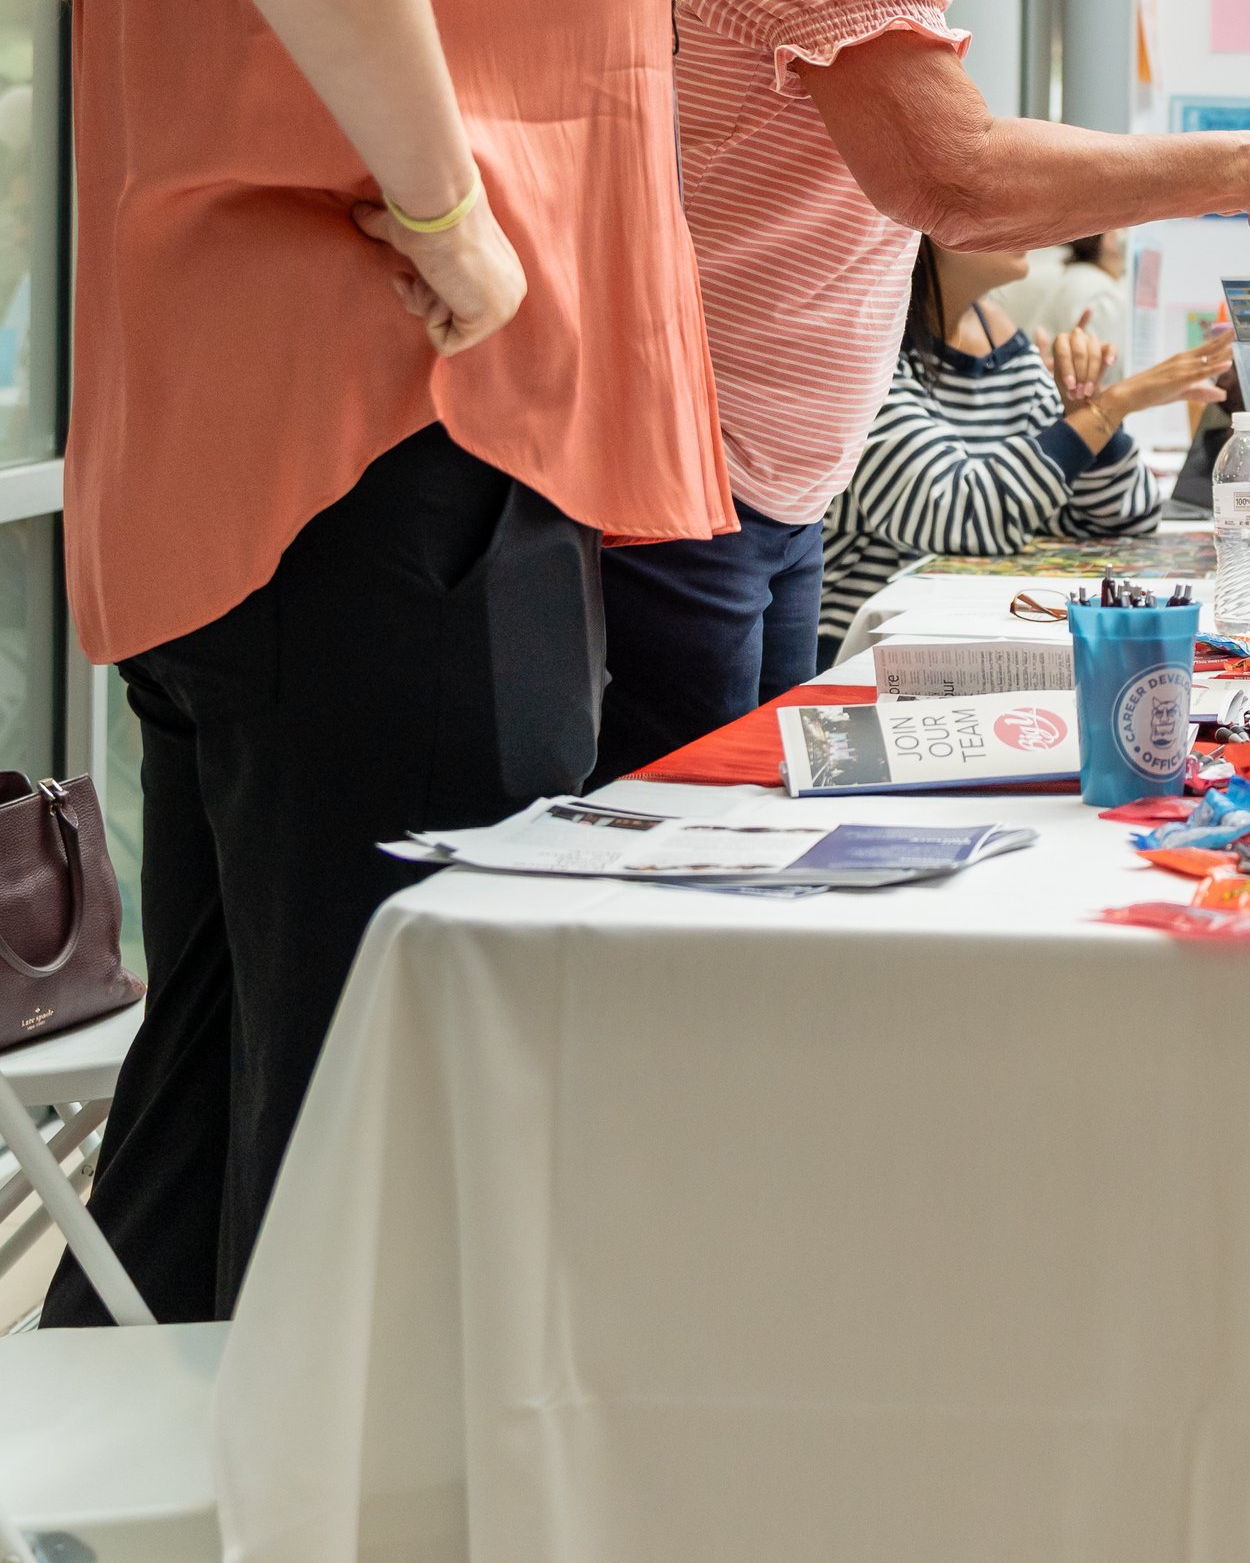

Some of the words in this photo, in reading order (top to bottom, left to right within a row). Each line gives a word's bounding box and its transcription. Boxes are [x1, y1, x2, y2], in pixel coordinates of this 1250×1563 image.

[1122, 685, 1148, 743] CAREER
[1147, 673, 1192, 695] DEVELO
[889, 716, 923, 762] JOIN
[922, 715, 954, 758] OUR
[951, 708, 987, 763] TEAM
